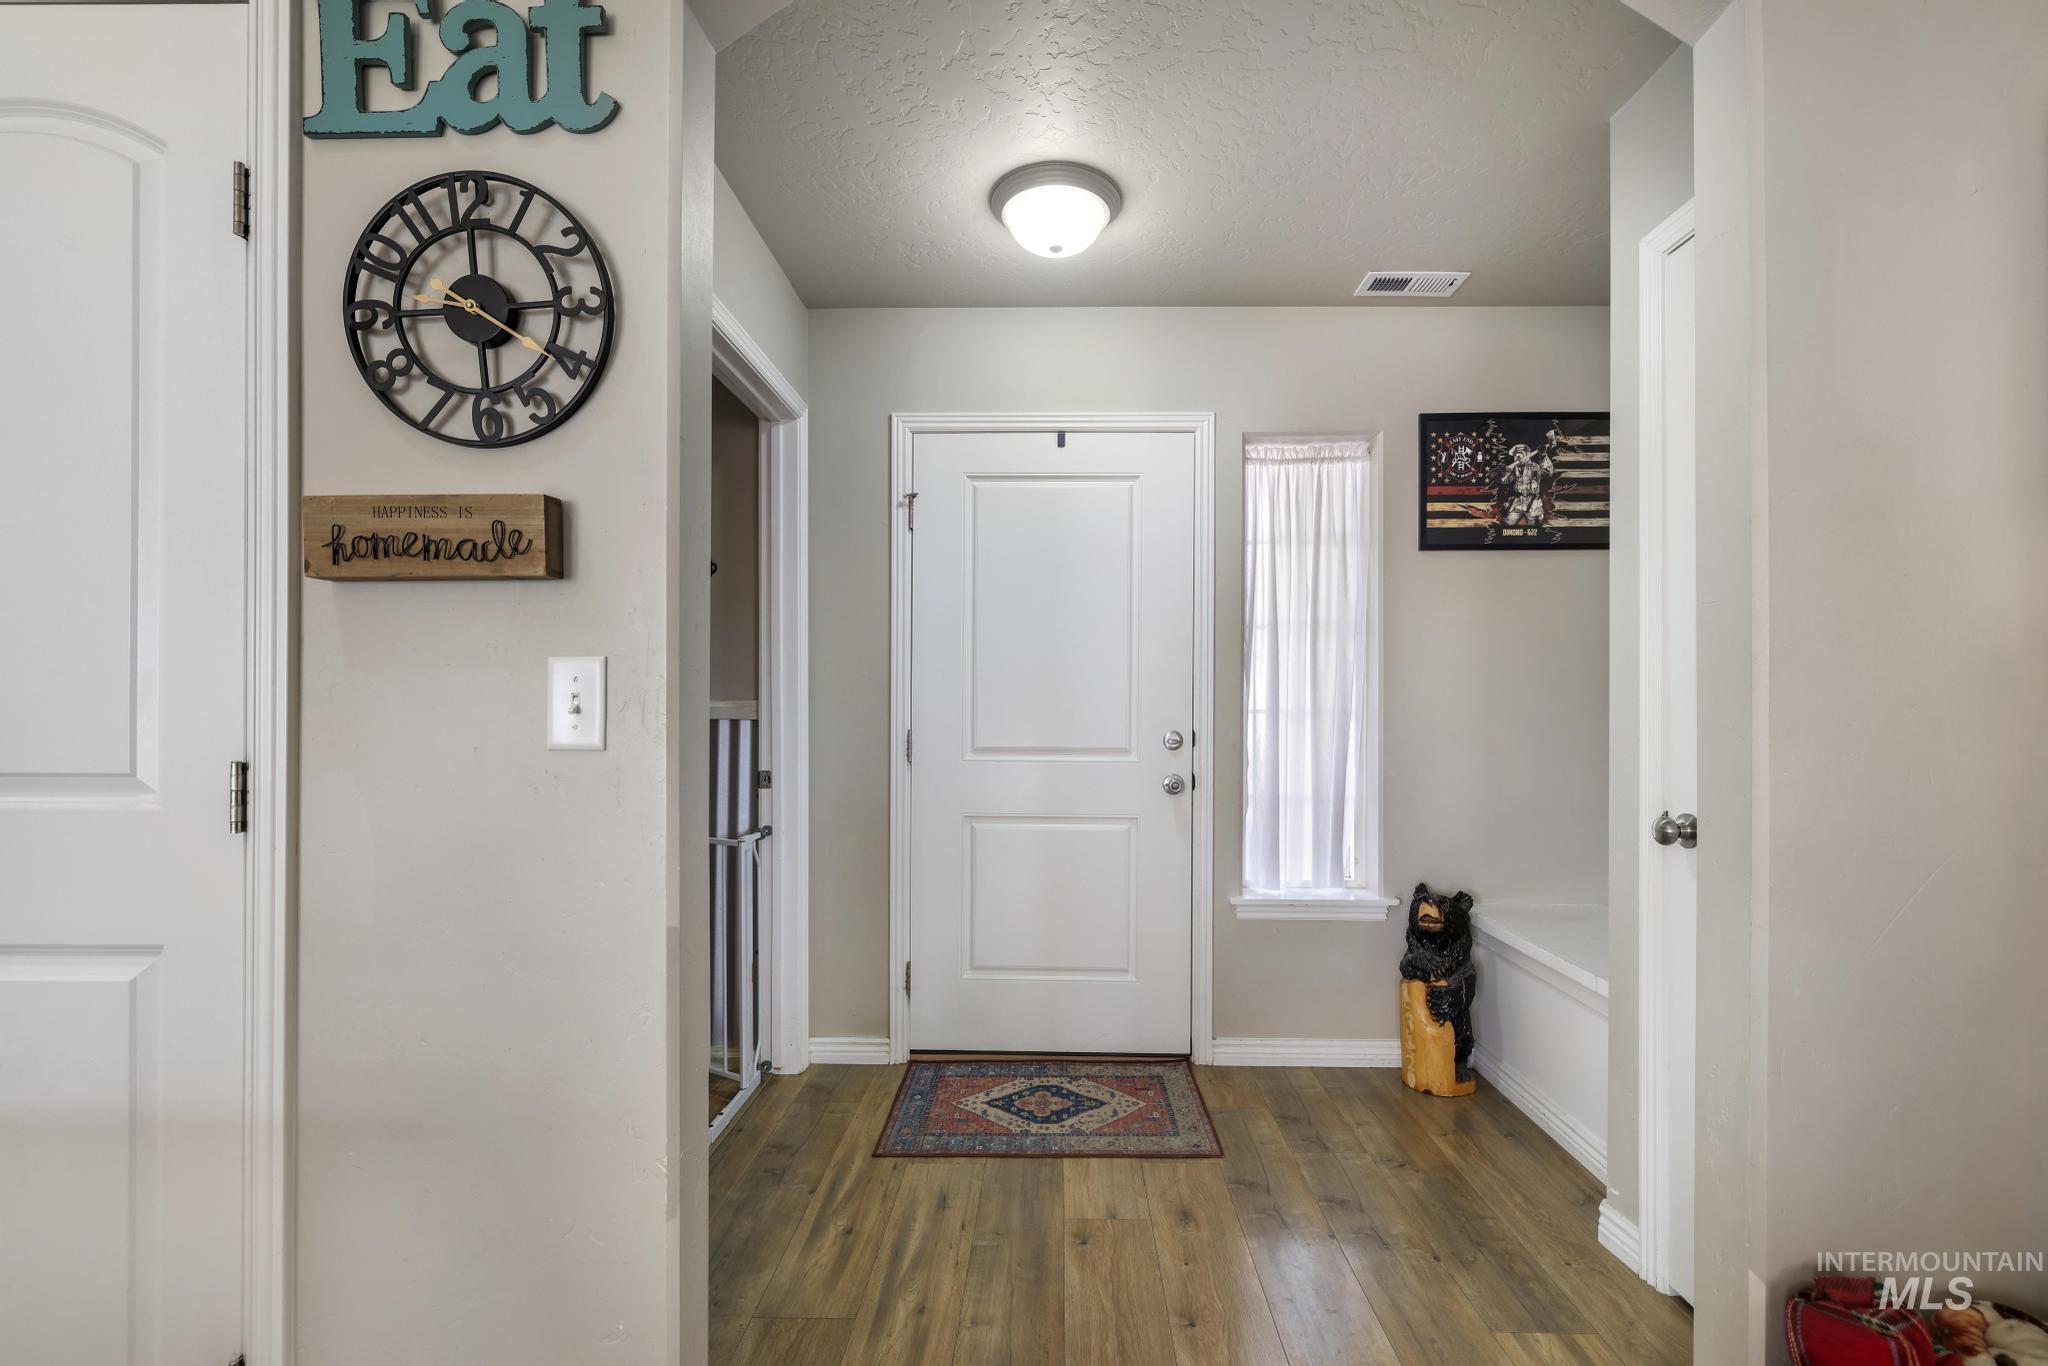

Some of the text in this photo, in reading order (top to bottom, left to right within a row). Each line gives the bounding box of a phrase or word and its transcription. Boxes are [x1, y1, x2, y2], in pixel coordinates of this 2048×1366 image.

[303, 0, 621, 138] Eat
[389, 189, 440, 246] 11
[440, 172, 492, 228] 12
[507, 187, 537, 237] 1
[353, 233, 408, 284] 10
[532, 226, 588, 274] 2
[349, 299, 396, 331] 9
[554, 285, 607, 318] 3
[366, 348, 414, 392] 8
[548, 341, 597, 380] 4
[418, 375, 457, 431] 7
[472, 390, 504, 443] 6
[512, 371, 557, 426] 5
[372, 505, 473, 519] HAPPINESS IS
[321, 520, 533, 566] homemade
